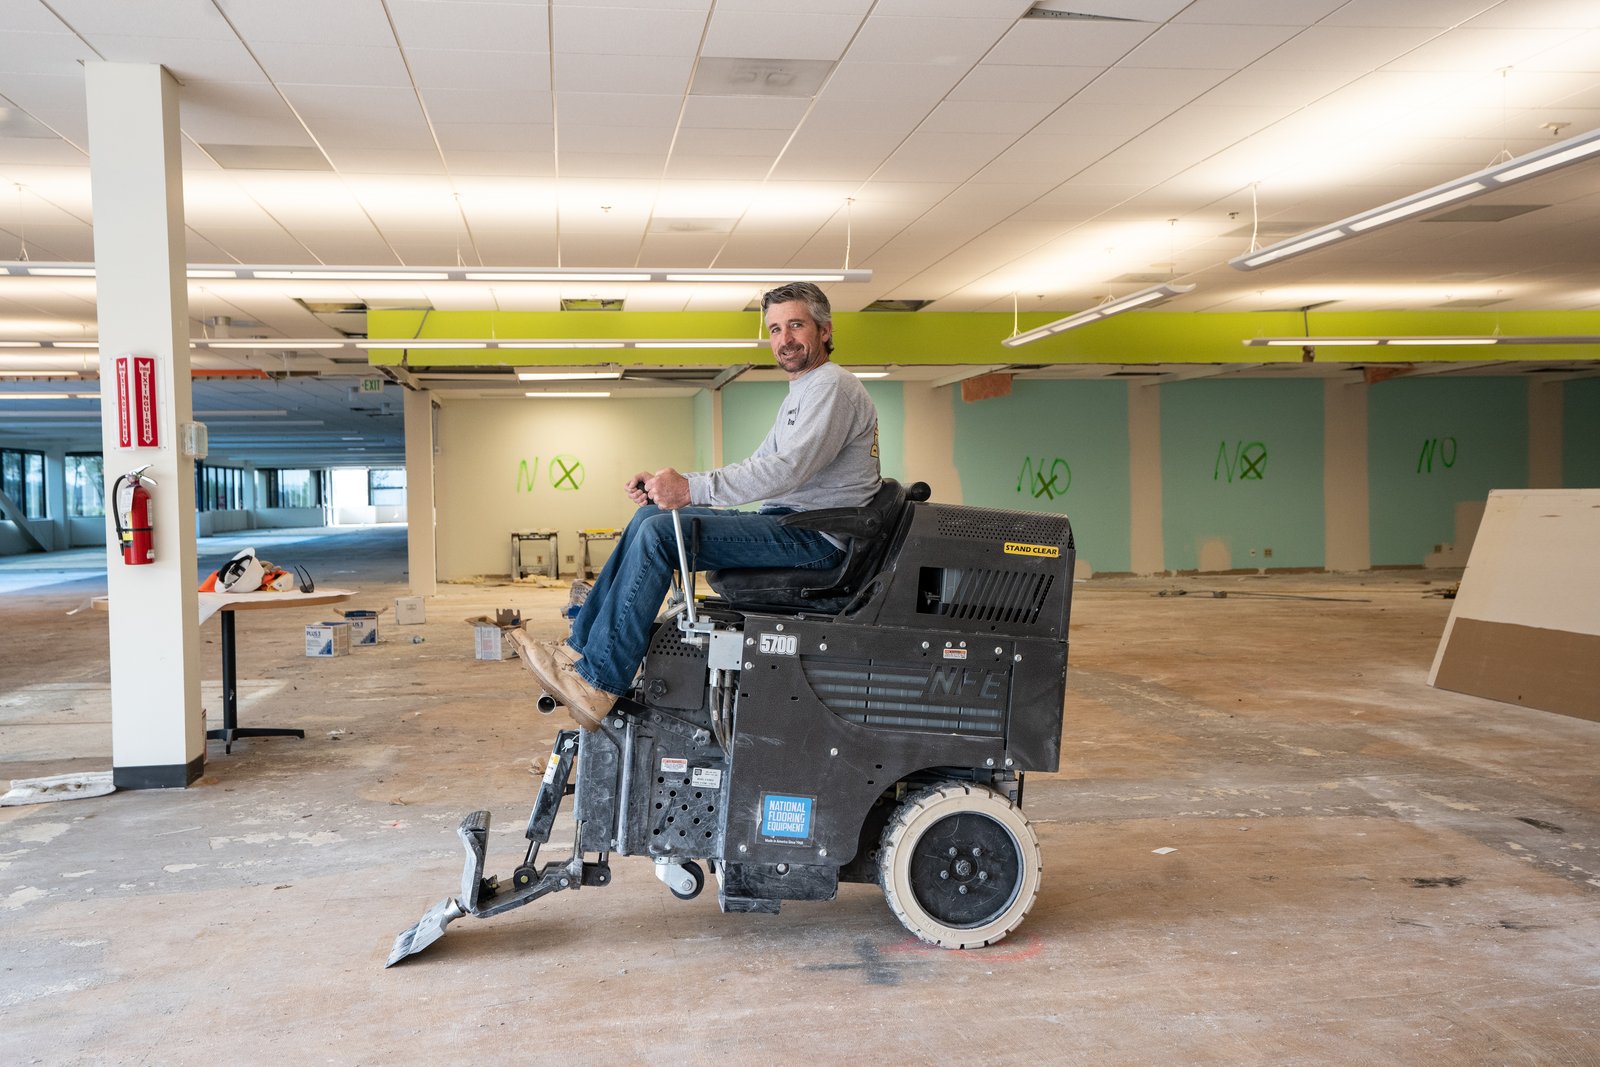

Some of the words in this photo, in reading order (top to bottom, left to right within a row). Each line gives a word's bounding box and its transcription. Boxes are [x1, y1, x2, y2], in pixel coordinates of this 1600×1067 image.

[364, 379, 380, 391] EXIT
[142, 372, 151, 441] EXTINGUISHER
[1417, 437, 1457, 474] NO
[1005, 544, 1032, 553] STAND
[1032, 547, 1057, 555] CLEAR
[306, 630, 318, 638] PLUS
[760, 633, 798, 655] 5700
[926, 664, 1007, 699] NFE
[769, 800, 806, 813] NATIONAL
[768, 811, 806, 824] FLOORING
[767, 821, 805, 833] EQUIPMENT
